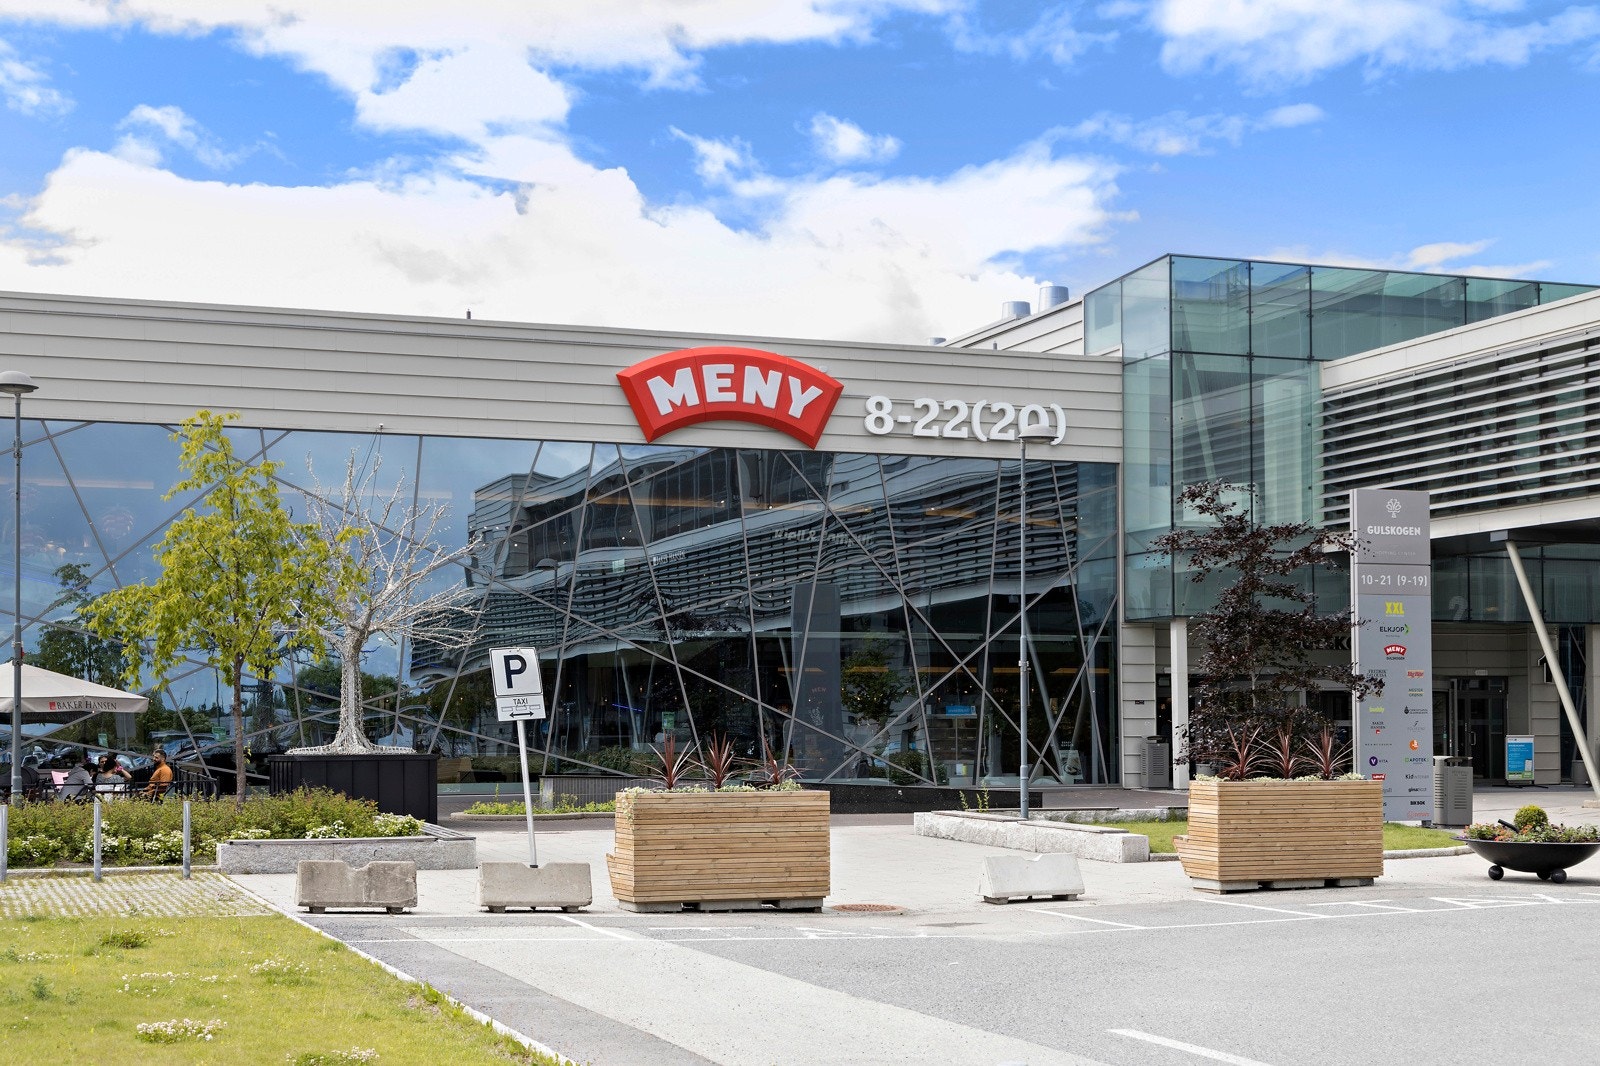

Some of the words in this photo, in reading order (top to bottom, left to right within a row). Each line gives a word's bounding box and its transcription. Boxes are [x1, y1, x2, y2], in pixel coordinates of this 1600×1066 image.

[646, 364, 823, 419] MENY
[864, 395, 1067, 446] 8-22(20)
[1367, 525, 1421, 536] GULSKOGEN
[1361, 574, 1392, 585] 10-21
[1397, 574, 1428, 587] (9-19)
[1385, 602, 1405, 615] XXL
[503, 654, 527, 689] P
[85, 700, 117, 710] HANSEN
